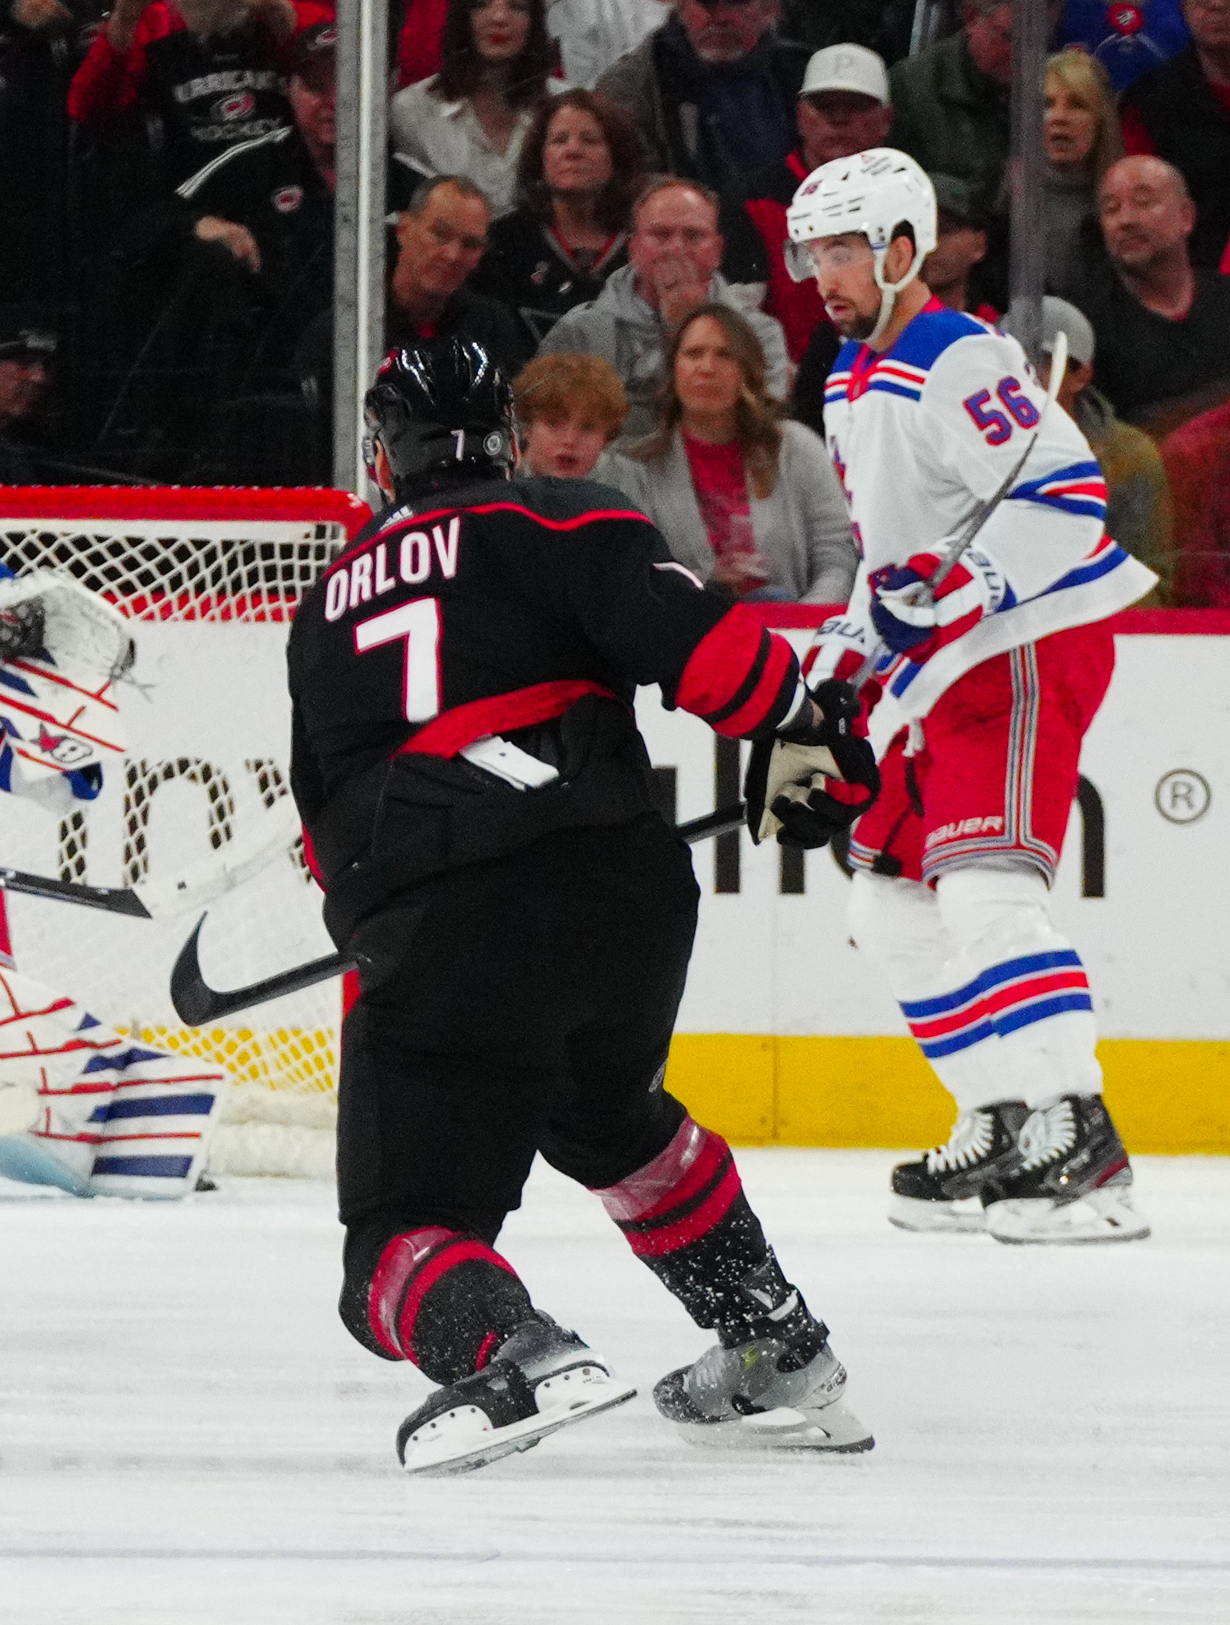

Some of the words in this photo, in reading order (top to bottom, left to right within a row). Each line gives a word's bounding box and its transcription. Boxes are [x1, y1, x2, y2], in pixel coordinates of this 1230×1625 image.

[450, 429, 465, 461] 7
[963, 376, 1041, 446] 56
[324, 516, 460, 622] ORLOV
[353, 597, 443, 723] 7
